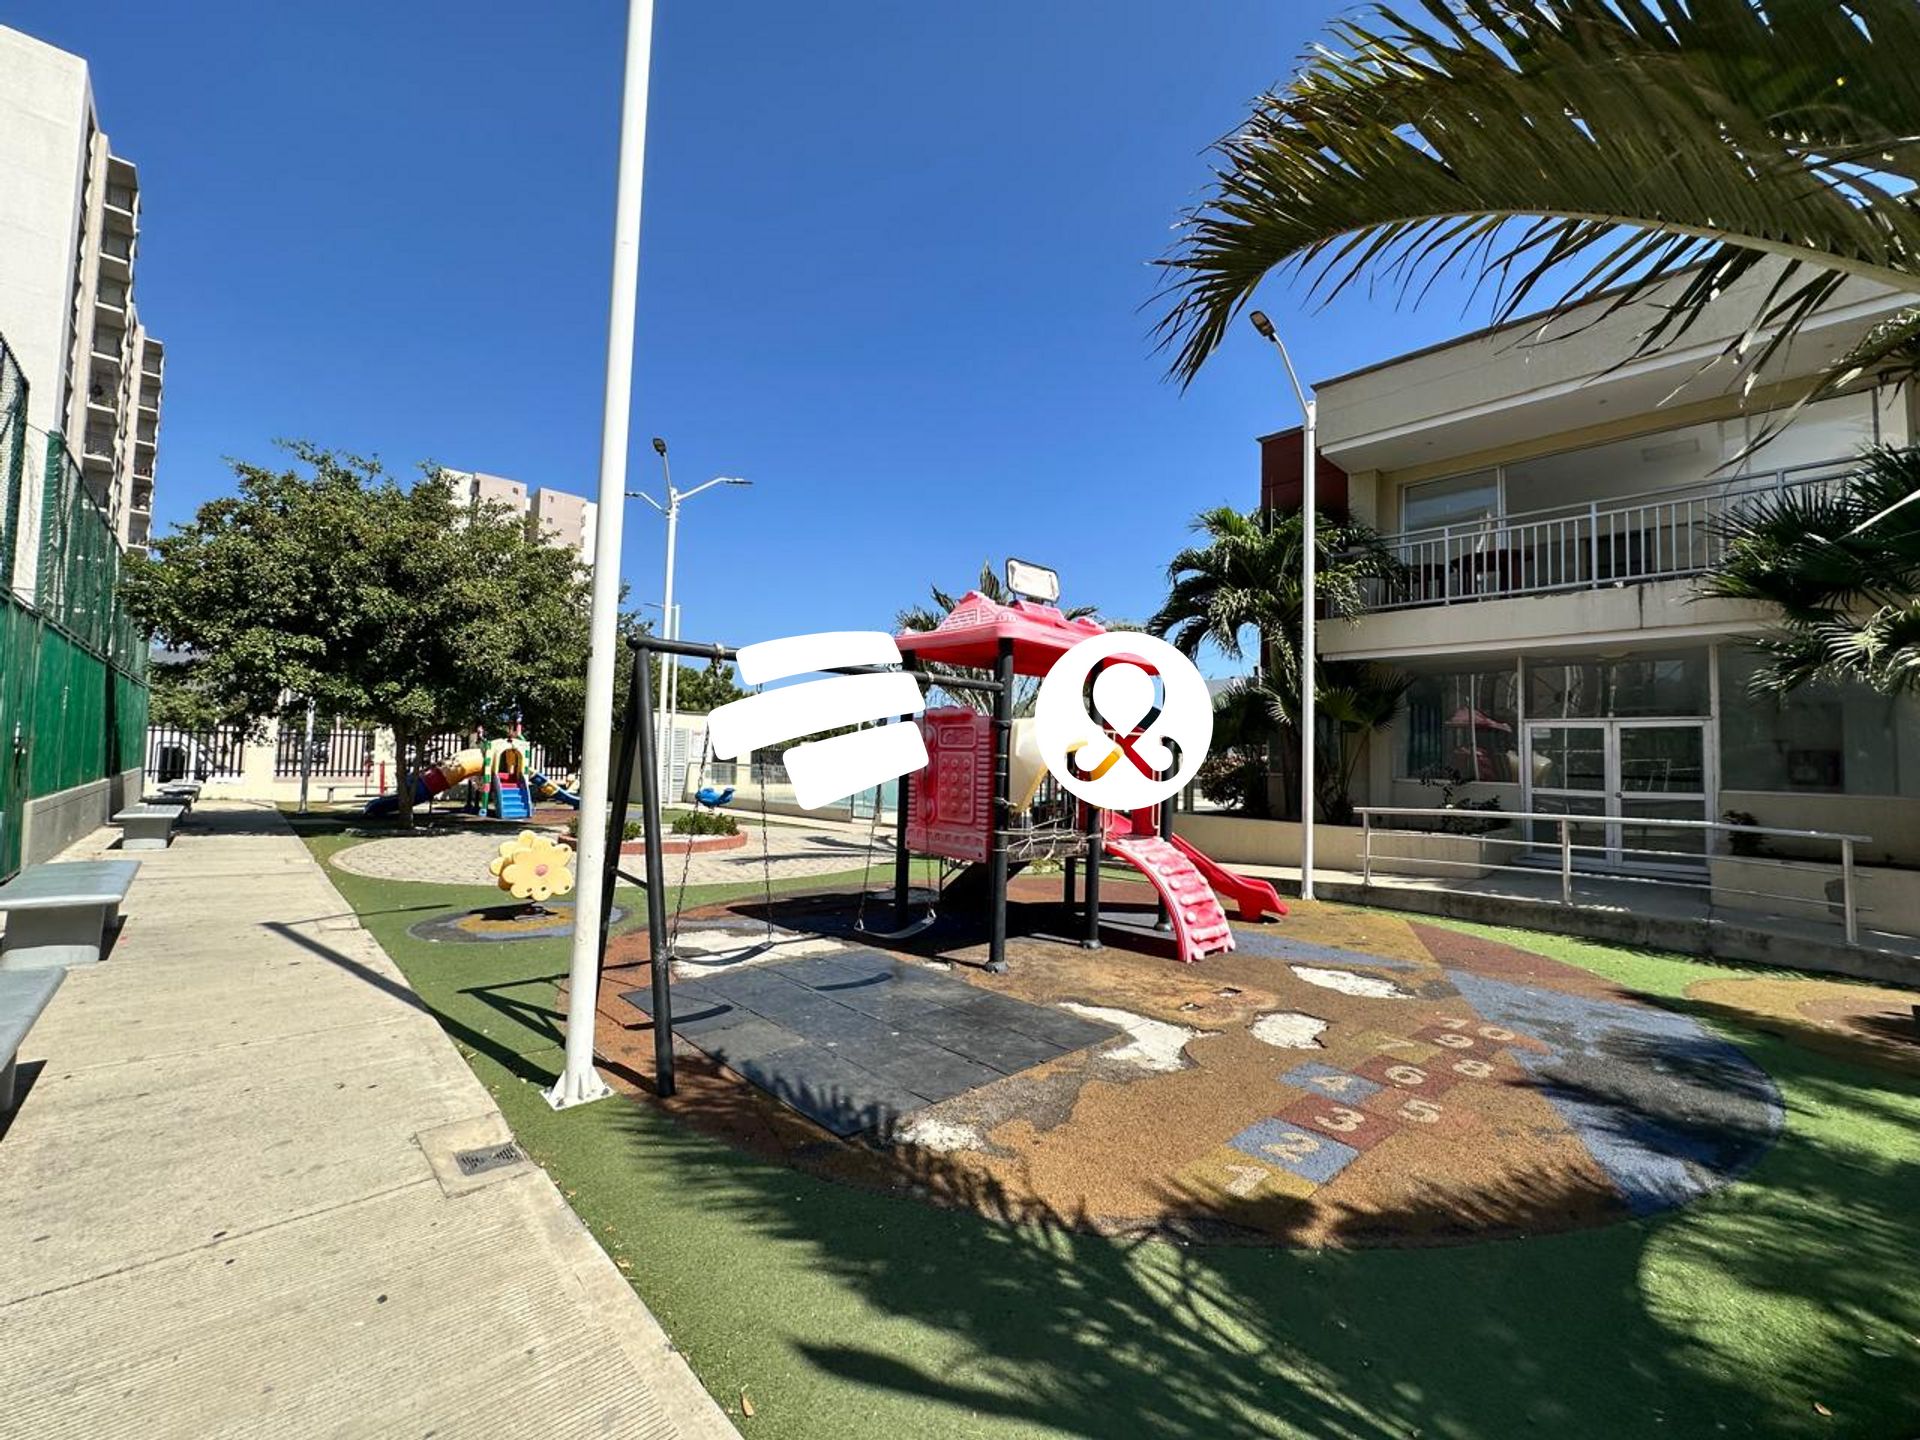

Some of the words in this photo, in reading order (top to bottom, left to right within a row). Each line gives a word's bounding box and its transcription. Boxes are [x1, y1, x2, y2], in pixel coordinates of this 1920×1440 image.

[1310, 1076, 1352, 1091] 4
[1385, 1065, 1428, 1084] 6
[1314, 1107, 1364, 1132] 3
[1399, 1100, 1442, 1123] 5
[1261, 1132, 1319, 1163] 2
[1224, 1163, 1269, 1196] 1
